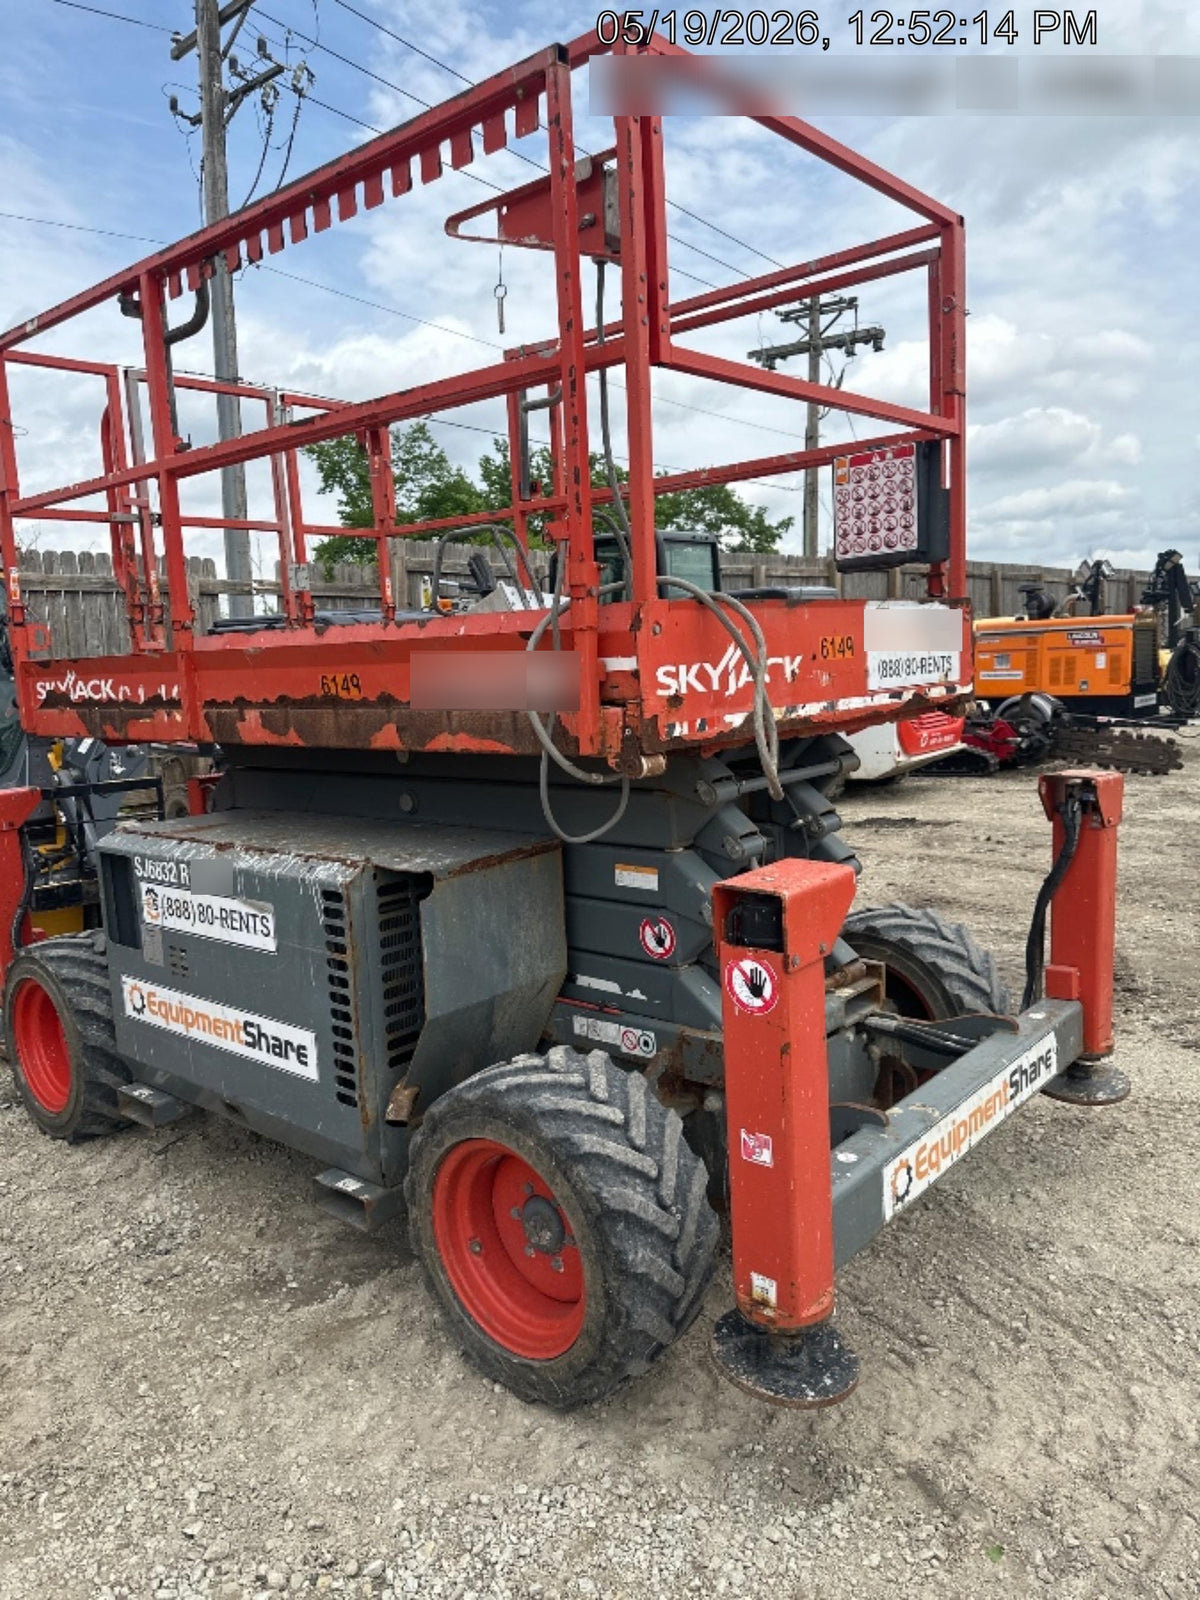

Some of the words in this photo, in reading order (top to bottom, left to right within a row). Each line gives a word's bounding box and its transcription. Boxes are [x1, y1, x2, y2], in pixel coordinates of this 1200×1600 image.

[821, 636, 854, 659] 6149
[321, 673, 362, 696] 6149
[134, 856, 178, 882] SJ6832
[146, 990, 309, 1067] EquipmentShare
[915, 1047, 1052, 1181] EquipmentShare
